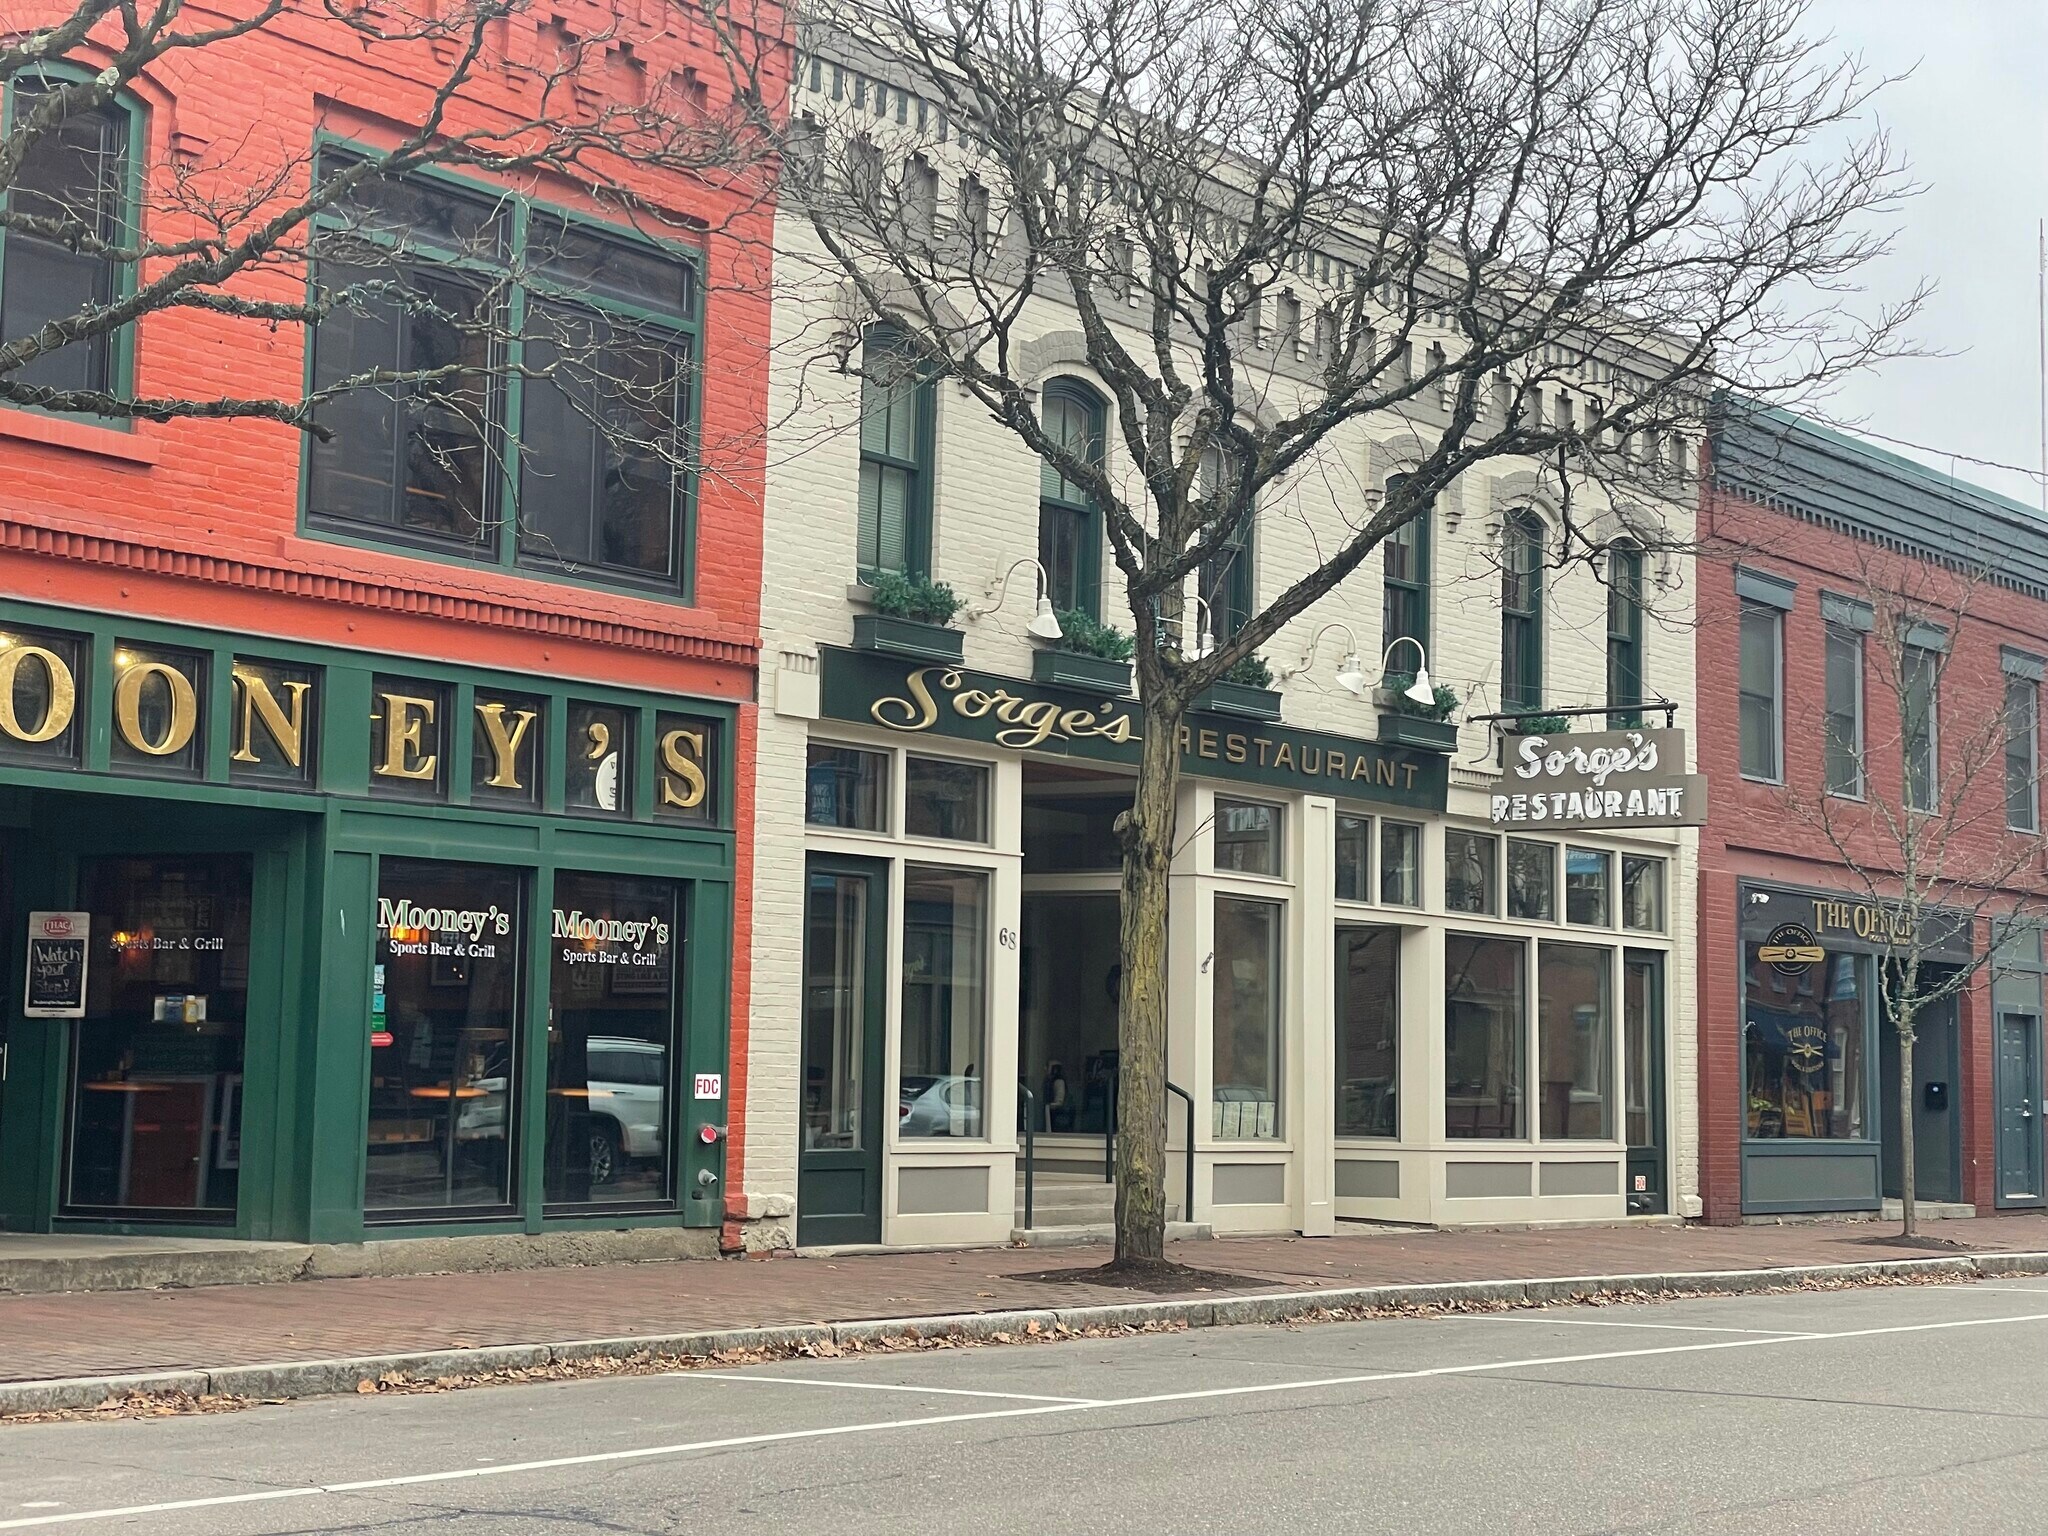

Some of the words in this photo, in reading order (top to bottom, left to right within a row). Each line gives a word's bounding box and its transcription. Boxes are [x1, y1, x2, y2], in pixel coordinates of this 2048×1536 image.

[871, 668, 1143, 748] Sorge's
[1514, 733, 1658, 787] Sorge's
[1491, 787, 1683, 824] RESTAURANT
[42, 920, 75, 931] ITHACA
[377, 898, 510, 942] Mooney's
[1812, 900, 1850, 932] THE
[551, 909, 669, 951] Mooney's
[999, 927, 1017, 951] 68
[36, 945, 80, 963] Watch
[152, 938, 176, 950] Bar
[178, 937, 190, 950] &
[194, 938, 223, 950] Grill
[390, 940, 428, 956] Sports
[430, 942, 452, 956] Bar
[454, 944, 466, 956] &
[468, 943, 496, 958] Grill
[563, 949, 596, 964] Sports
[598, 951, 618, 964] Bar
[620, 952, 630, 964] &
[632, 953, 657, 966] Grill
[696, 1079, 719, 1095] FDC
